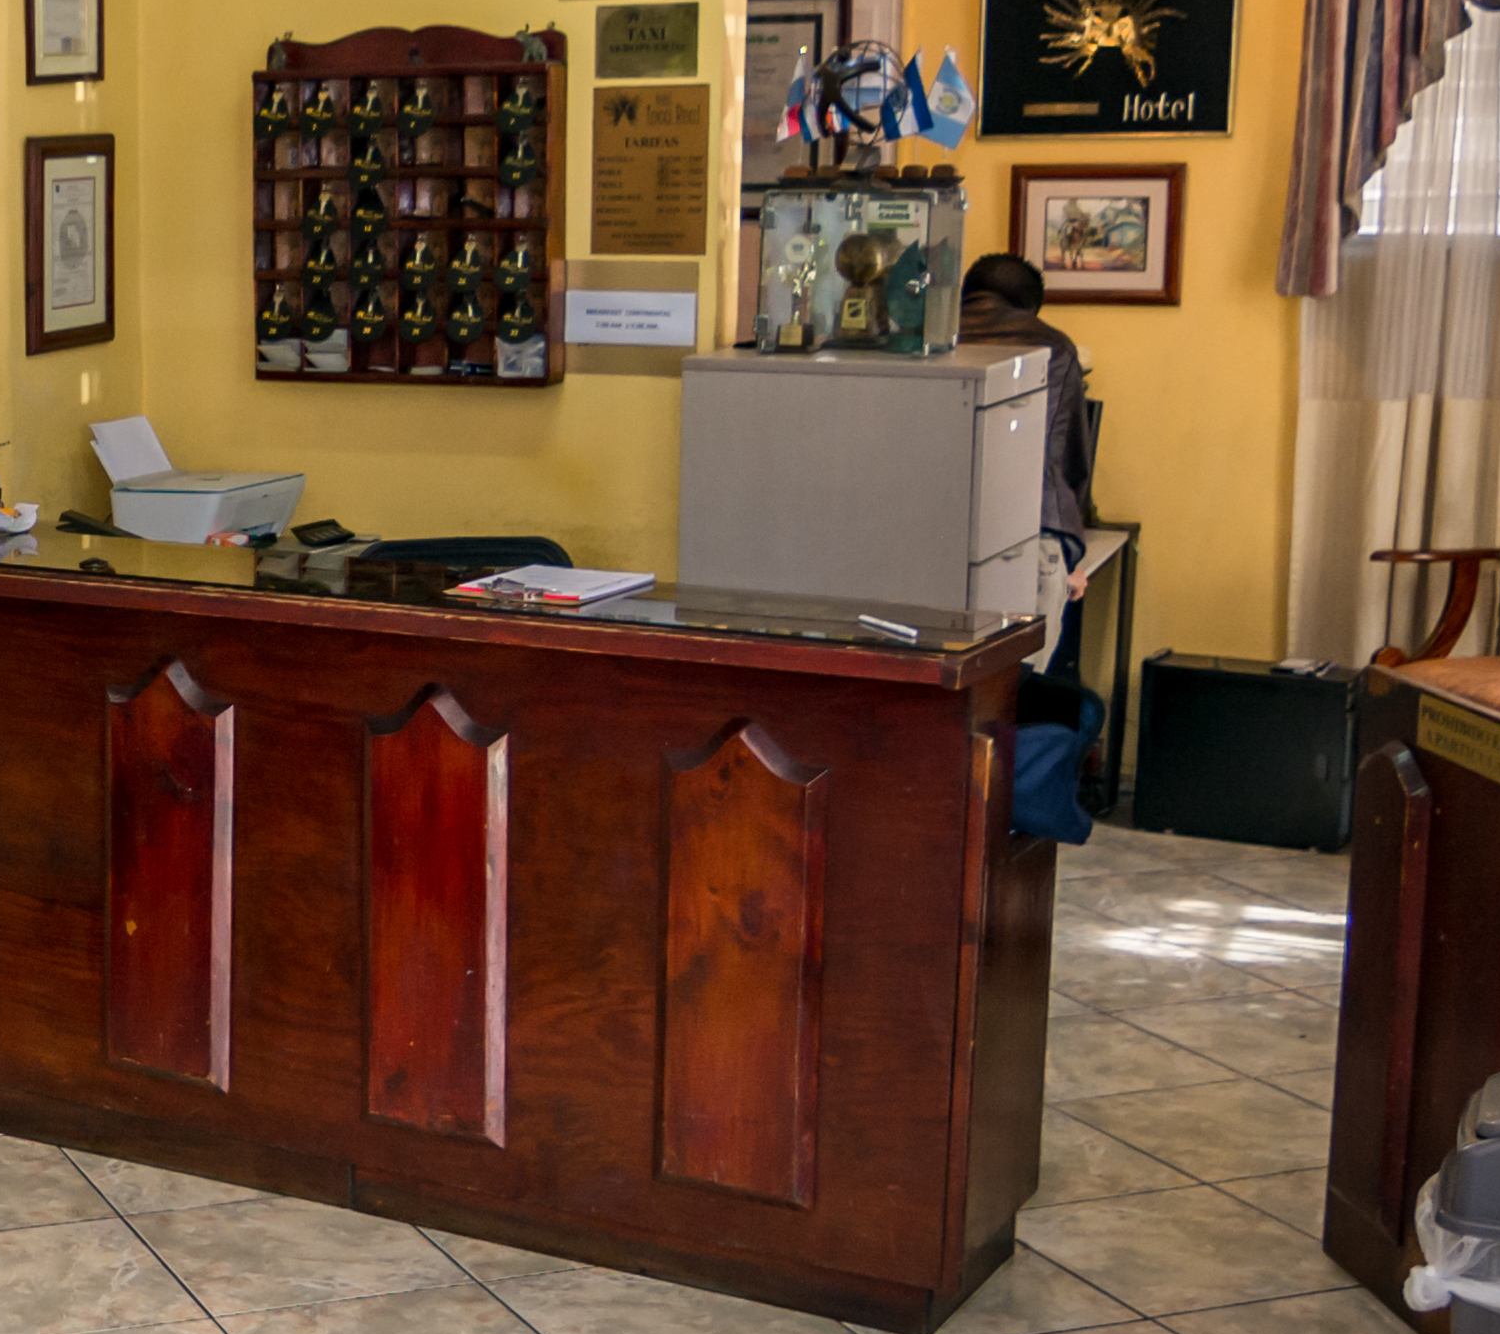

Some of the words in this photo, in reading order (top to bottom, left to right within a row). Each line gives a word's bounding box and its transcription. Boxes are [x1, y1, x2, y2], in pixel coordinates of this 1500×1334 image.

[628, 27, 667, 41] TAXI
[1123, 92, 1196, 122] Hotel
[625, 136, 679, 148] TARIFAS
